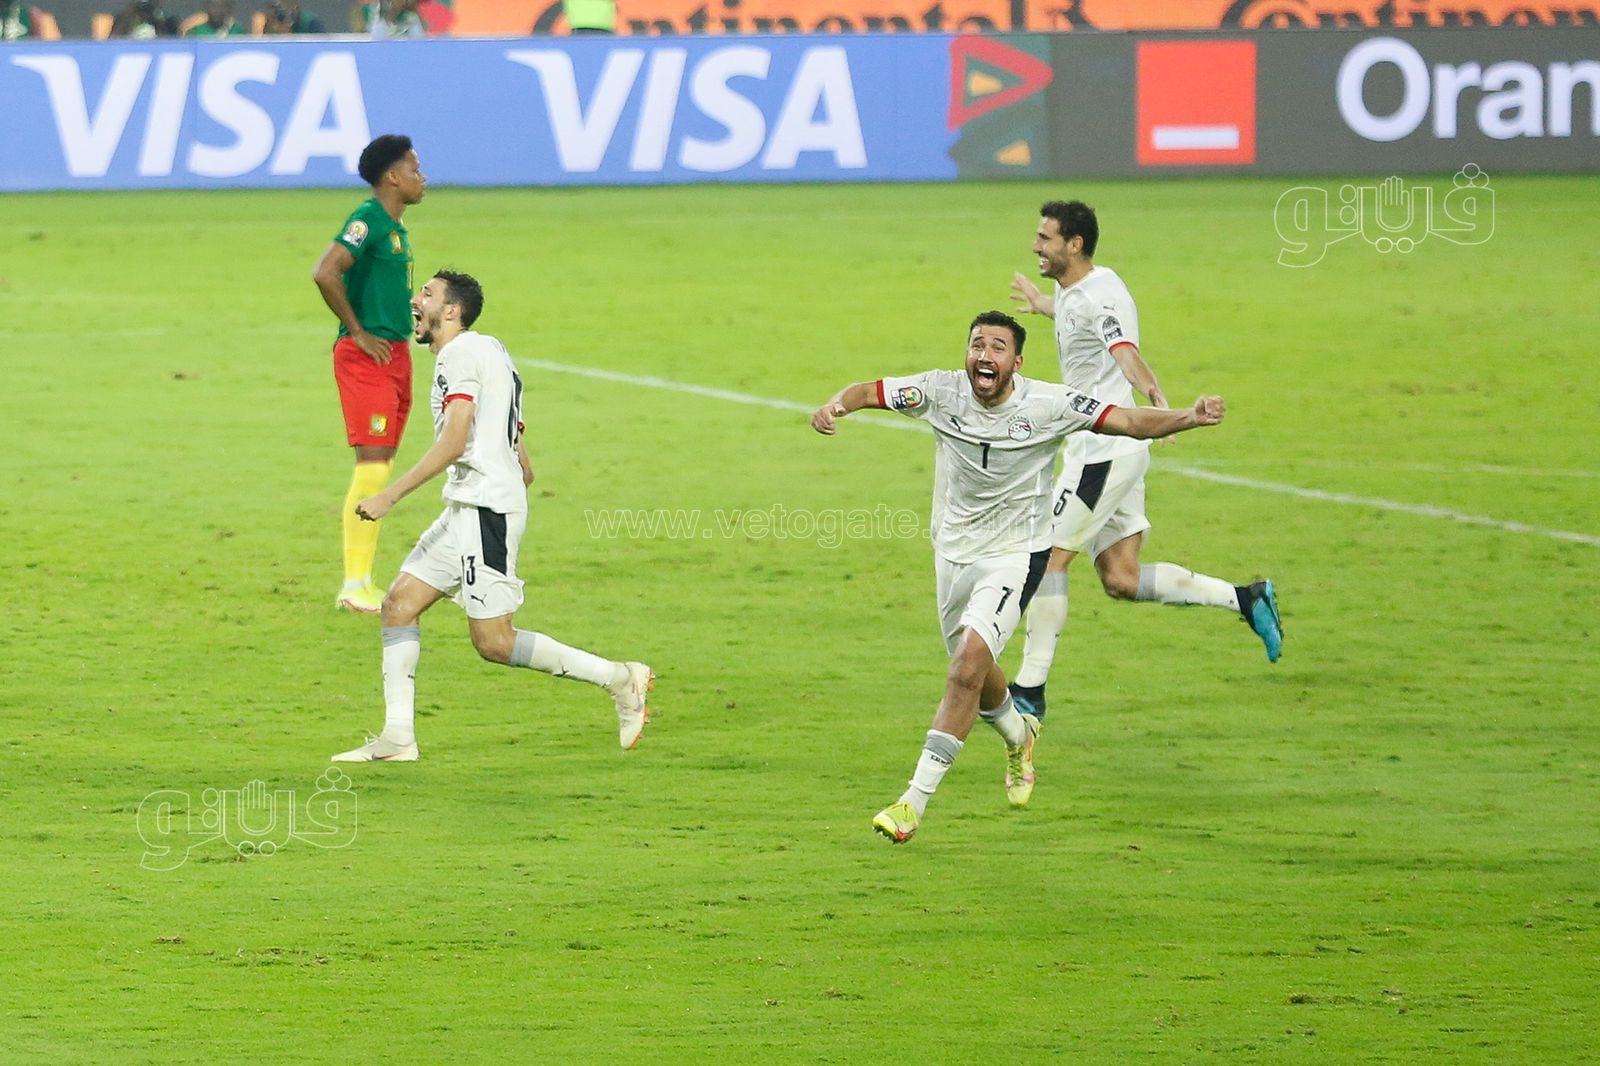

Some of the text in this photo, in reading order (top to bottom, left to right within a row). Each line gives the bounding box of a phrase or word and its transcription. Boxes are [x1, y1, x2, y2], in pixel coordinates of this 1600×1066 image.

[10, 50, 372, 178] VISA
[505, 45, 868, 172] VISA
[1336, 36, 1600, 142] Oran
[979, 441, 991, 469] 7
[461, 555, 476, 586] 13
[995, 586, 1014, 616] 7
